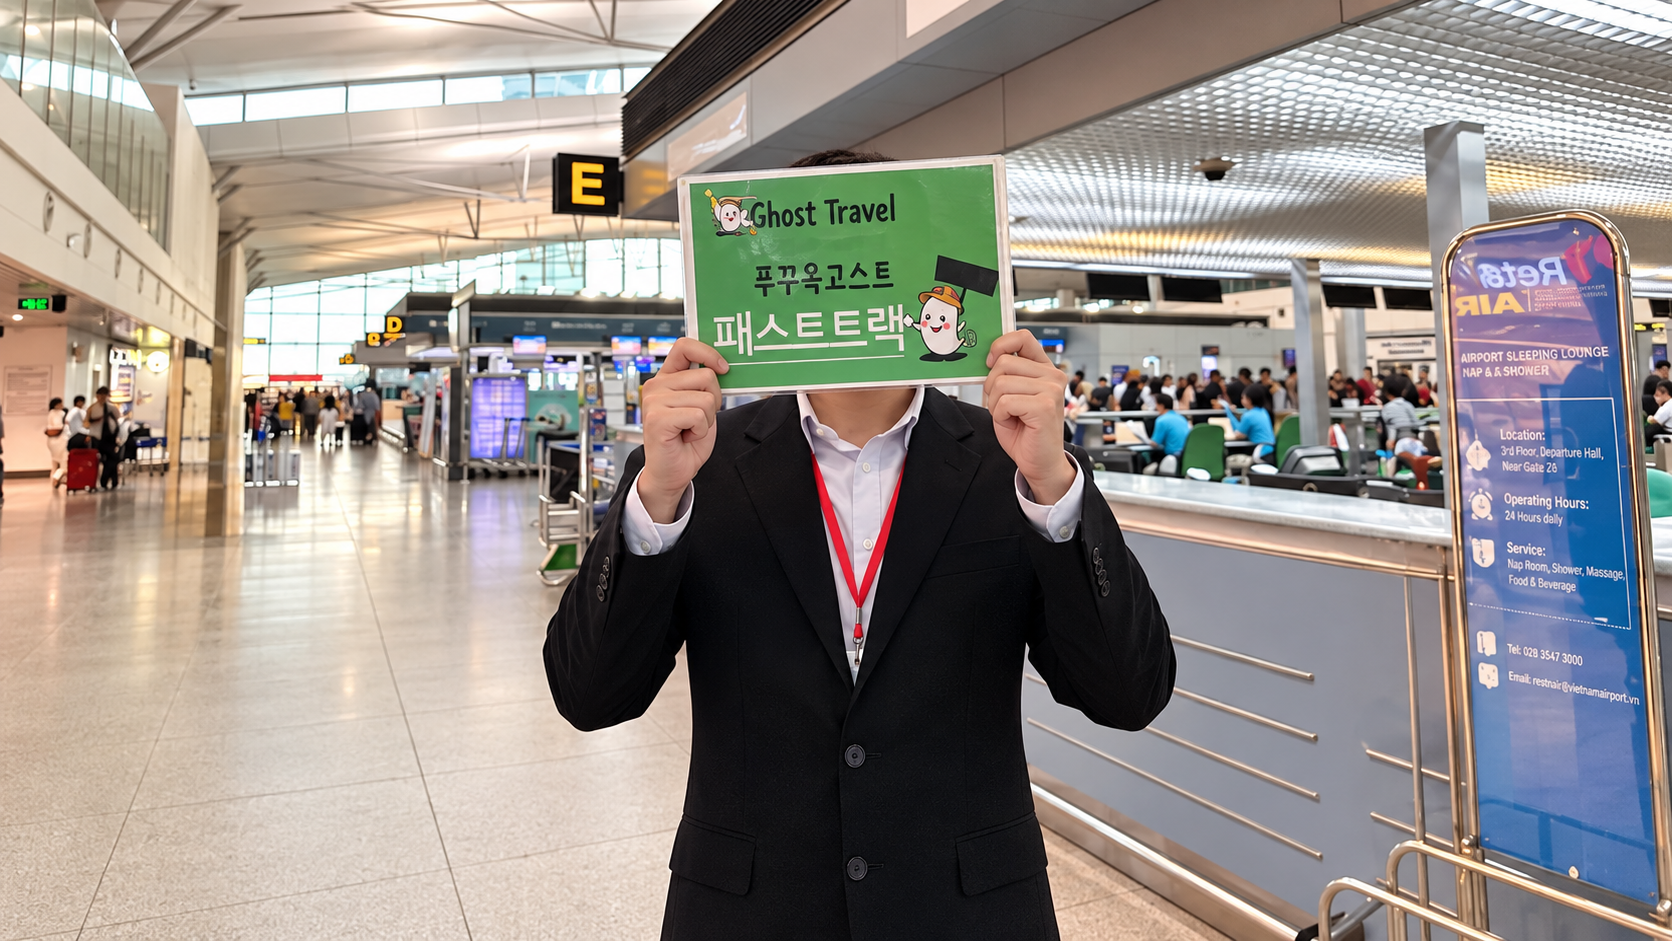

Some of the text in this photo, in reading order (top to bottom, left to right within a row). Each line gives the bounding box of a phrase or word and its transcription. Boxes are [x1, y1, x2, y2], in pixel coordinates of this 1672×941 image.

[571, 161, 606, 206] E
[750, 193, 896, 229] Ghost Travel
[754, 261, 894, 297] 푸꾸옥고스트
[386, 316, 403, 333] D
[713, 303, 905, 356] 패스트트랙
[1461, 346, 1609, 363] AIRPORT SLEEPING LOUNGE
[1462, 367, 1483, 378] NAP
[1503, 365, 1549, 377] SHOWER
[1500, 429, 1546, 441] Location:
[1501, 446, 1515, 456] 3rd
[1540, 446, 1582, 458] Departure
[1584, 447, 1604, 460] Hall,
[1502, 461, 1522, 472] Near
[1523, 462, 1545, 473] Gate
[1504, 492, 1589, 510] Operating Hours:
[1505, 510, 1515, 521] 24
[1517, 511, 1541, 523] Hours
[1506, 541, 1546, 556] Service:
[1507, 558, 1625, 581] Nap Room, Shower, Massage,
[1508, 574, 1528, 586] Food
[1538, 577, 1576, 594] Beverage
[1507, 643, 1522, 655] Tel:
[1540, 649, 1560, 662] 3547
[1561, 652, 1583, 667] 3000
